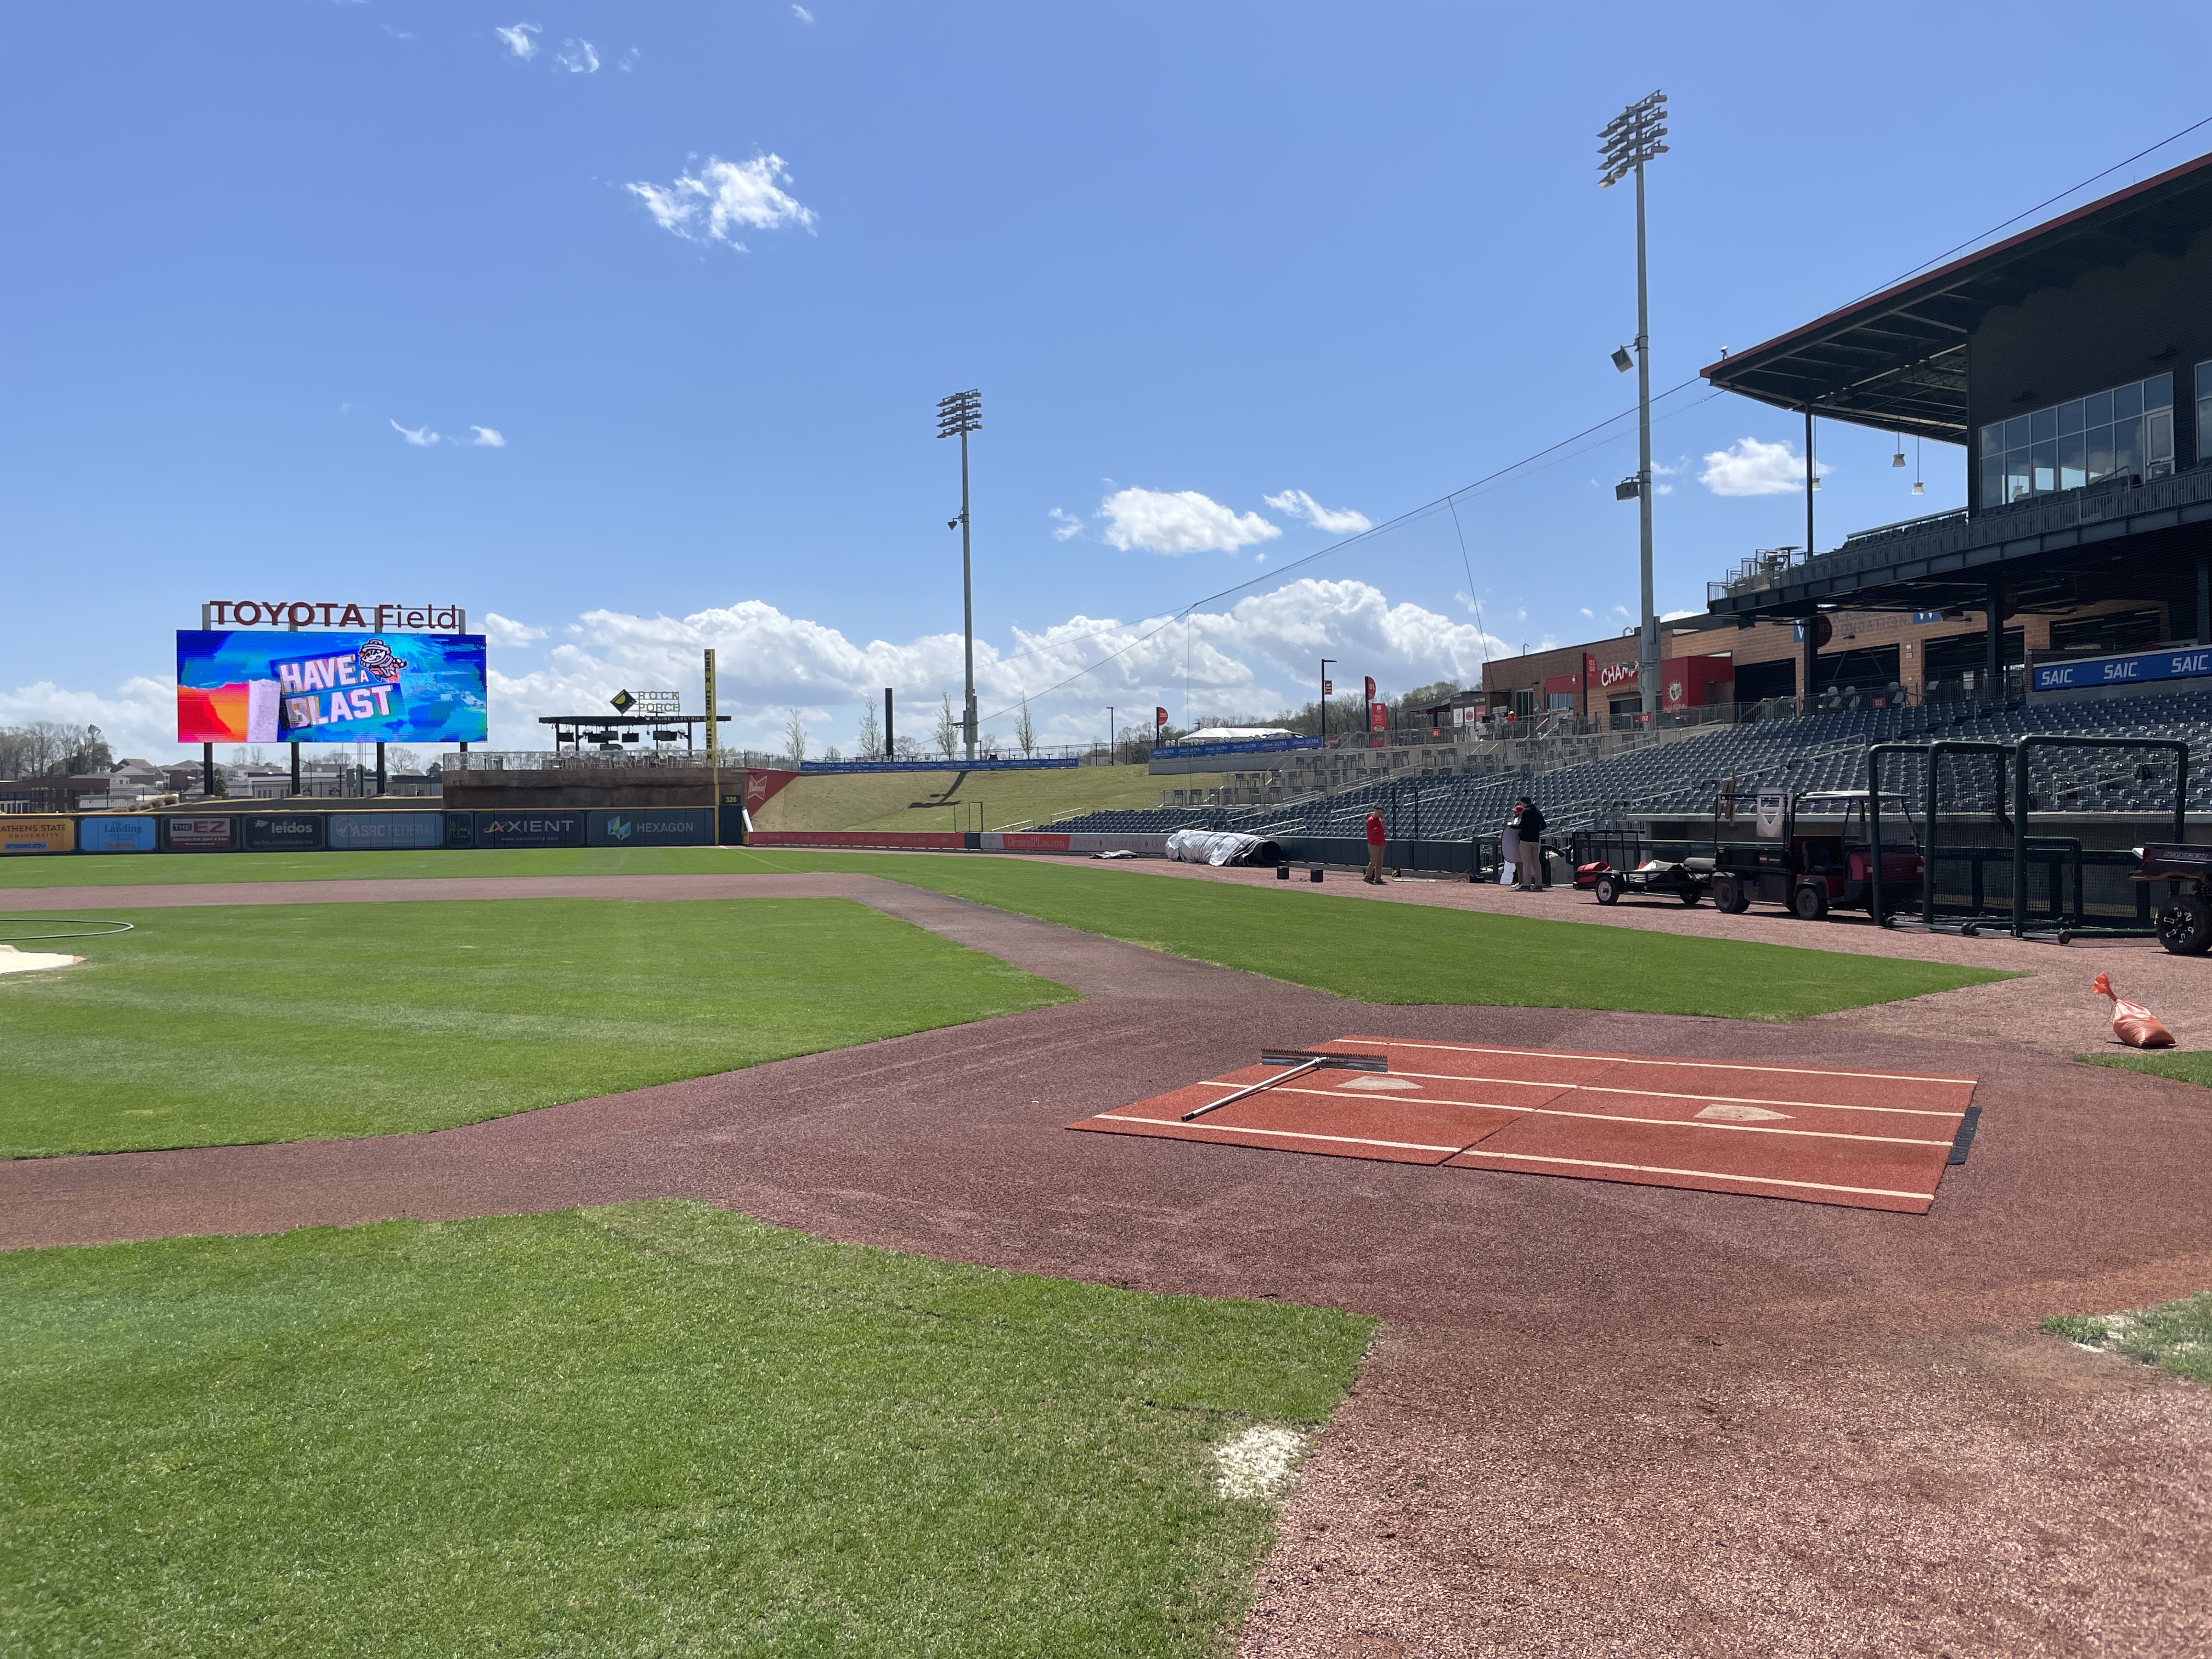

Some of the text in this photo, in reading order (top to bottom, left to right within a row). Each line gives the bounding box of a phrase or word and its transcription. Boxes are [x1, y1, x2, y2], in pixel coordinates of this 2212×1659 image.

[210, 600, 456, 629] TOYOTA Field
[2170, 654, 2209, 673] SAIC
[279, 654, 369, 694] HAVE A
[2040, 668, 2073, 686] SAIC
[2103, 662, 2138, 680] SAIC
[638, 691, 680, 699] ROCK
[285, 685, 393, 729] BLAST
[638, 703, 681, 712] PORCH
[104, 823, 143, 834] Landing
[193, 820, 225, 833] EZ
[272, 821, 314, 833] leidos
[352, 825, 386, 837] ASRC
[388, 824, 435, 837] FEDERAL
[488, 820, 575, 833] AXIENT
[636, 822, 693, 833] HEXAGON
